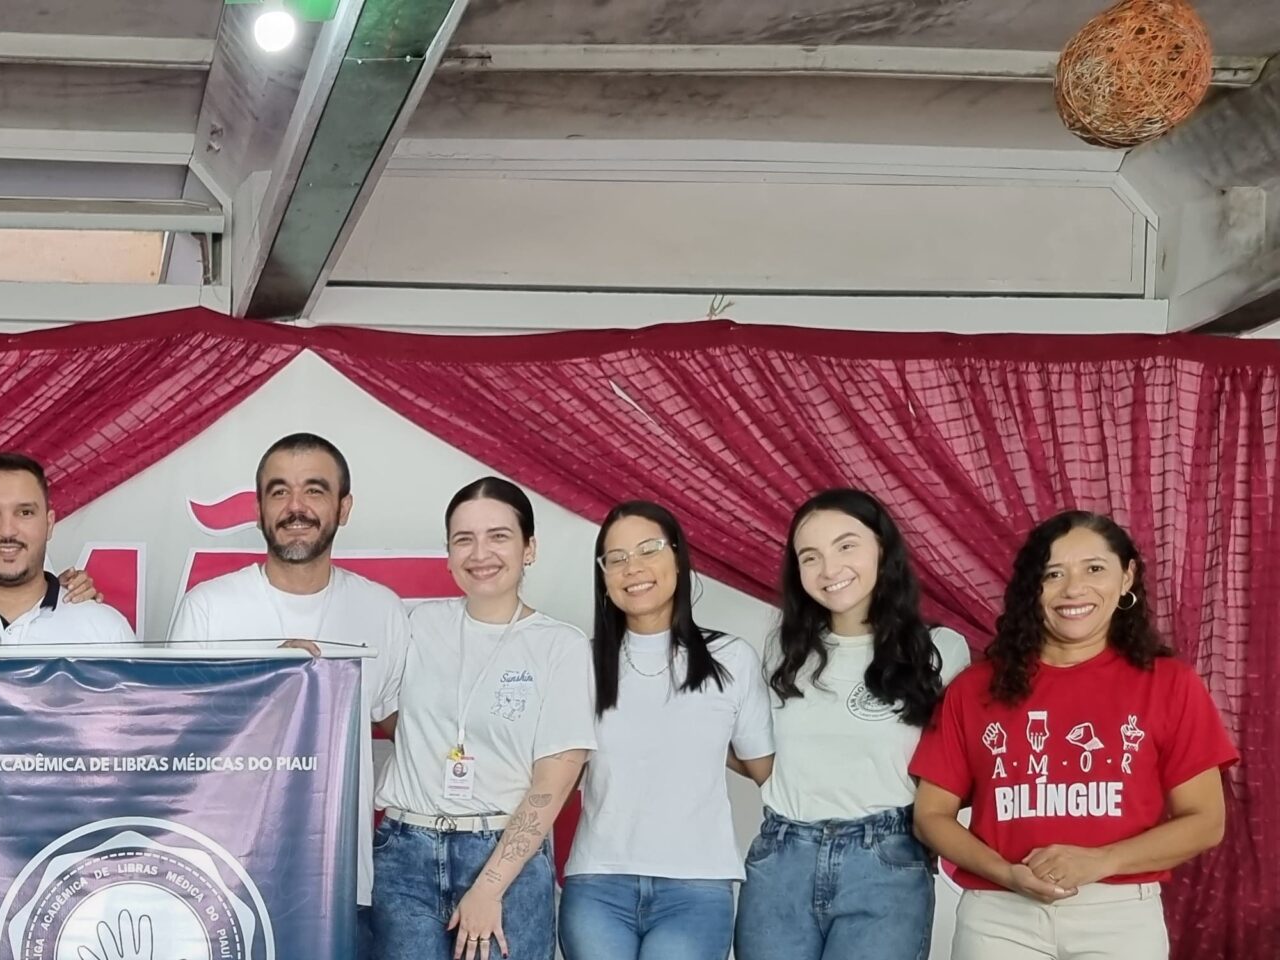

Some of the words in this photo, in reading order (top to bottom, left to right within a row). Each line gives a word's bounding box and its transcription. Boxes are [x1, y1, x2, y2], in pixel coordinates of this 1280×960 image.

[90, 757, 110, 772] DE
[113, 756, 169, 772] LIBRAS
[172, 753, 245, 772] MÉDICAS
[248, 757, 272, 771] DO
[276, 757, 318, 771] PIAUI
[995, 774, 1124, 822] BILÍNGUE
[42, 876, 88, 931] ACADÊMICA
[94, 867, 110, 880] DE
[118, 863, 159, 876] LIBRAS
[166, 870, 204, 903] MÉDICA
[205, 905, 219, 922] DO
